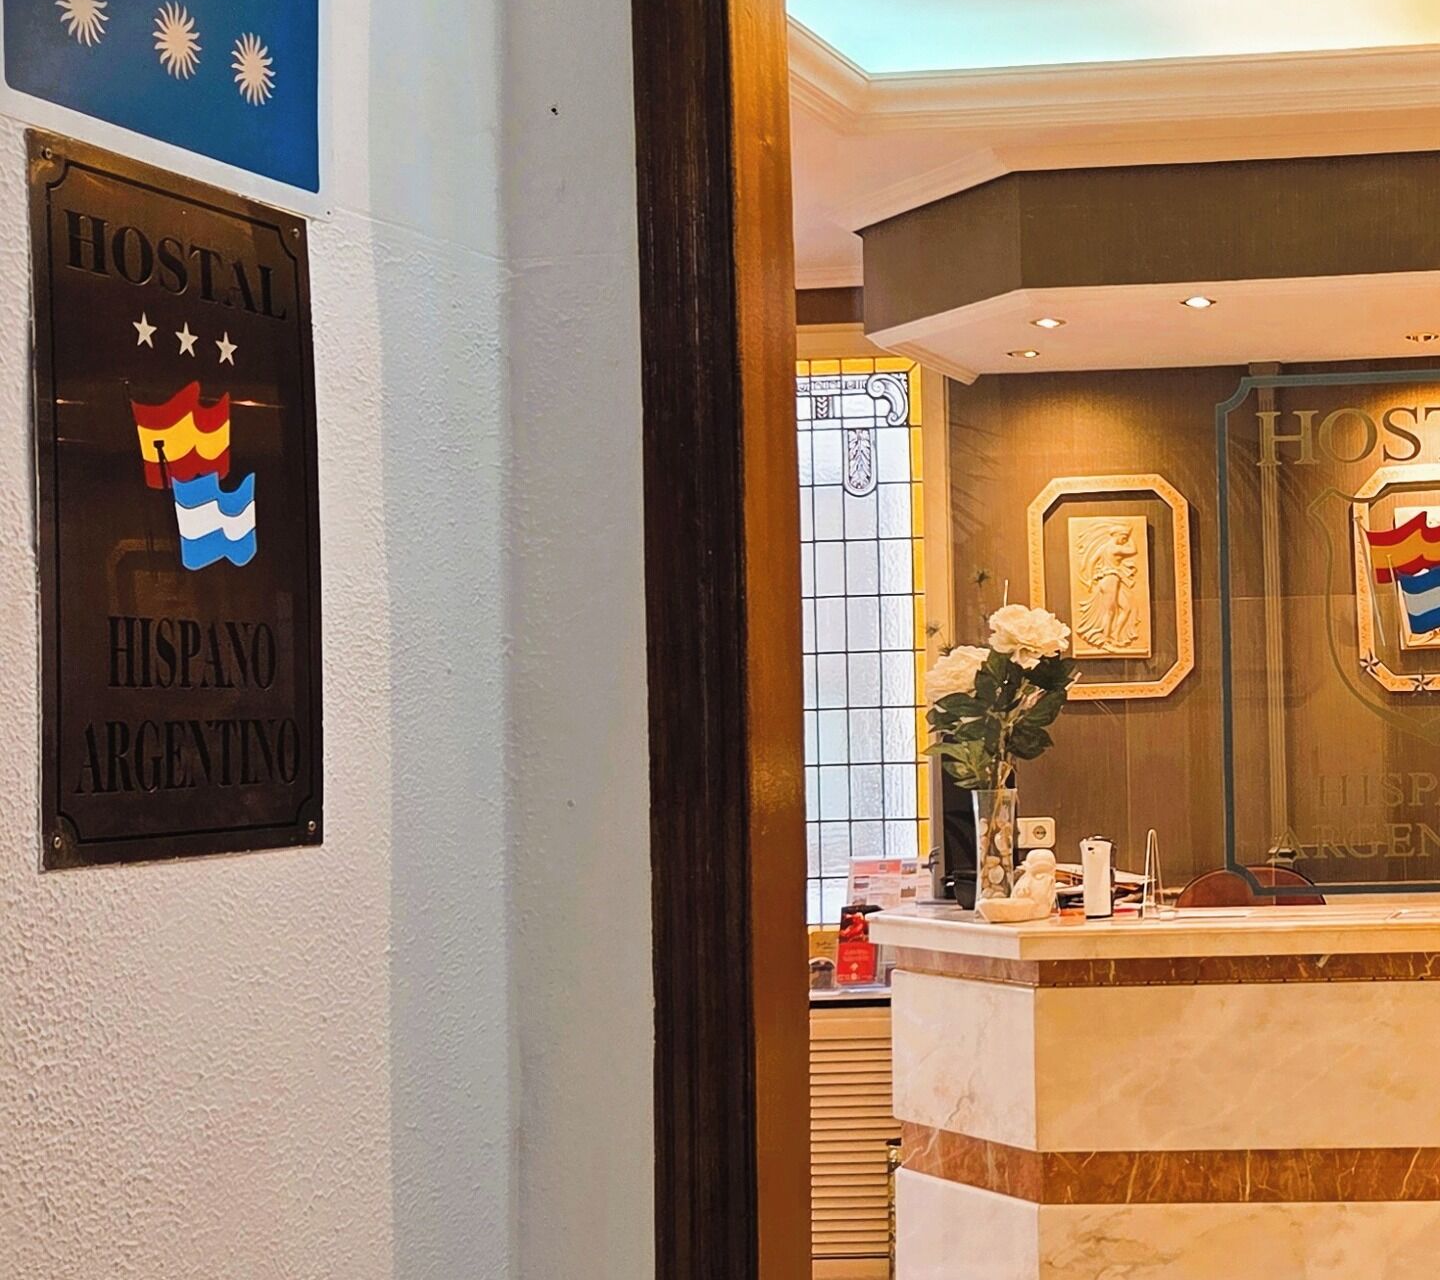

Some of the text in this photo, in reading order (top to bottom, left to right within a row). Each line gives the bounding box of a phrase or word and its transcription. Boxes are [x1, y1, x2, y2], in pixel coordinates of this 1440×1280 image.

[64, 209, 288, 321] HOSTAL
[107, 615, 277, 690] HISPANO
[74, 717, 302, 794] ARGENTINO
